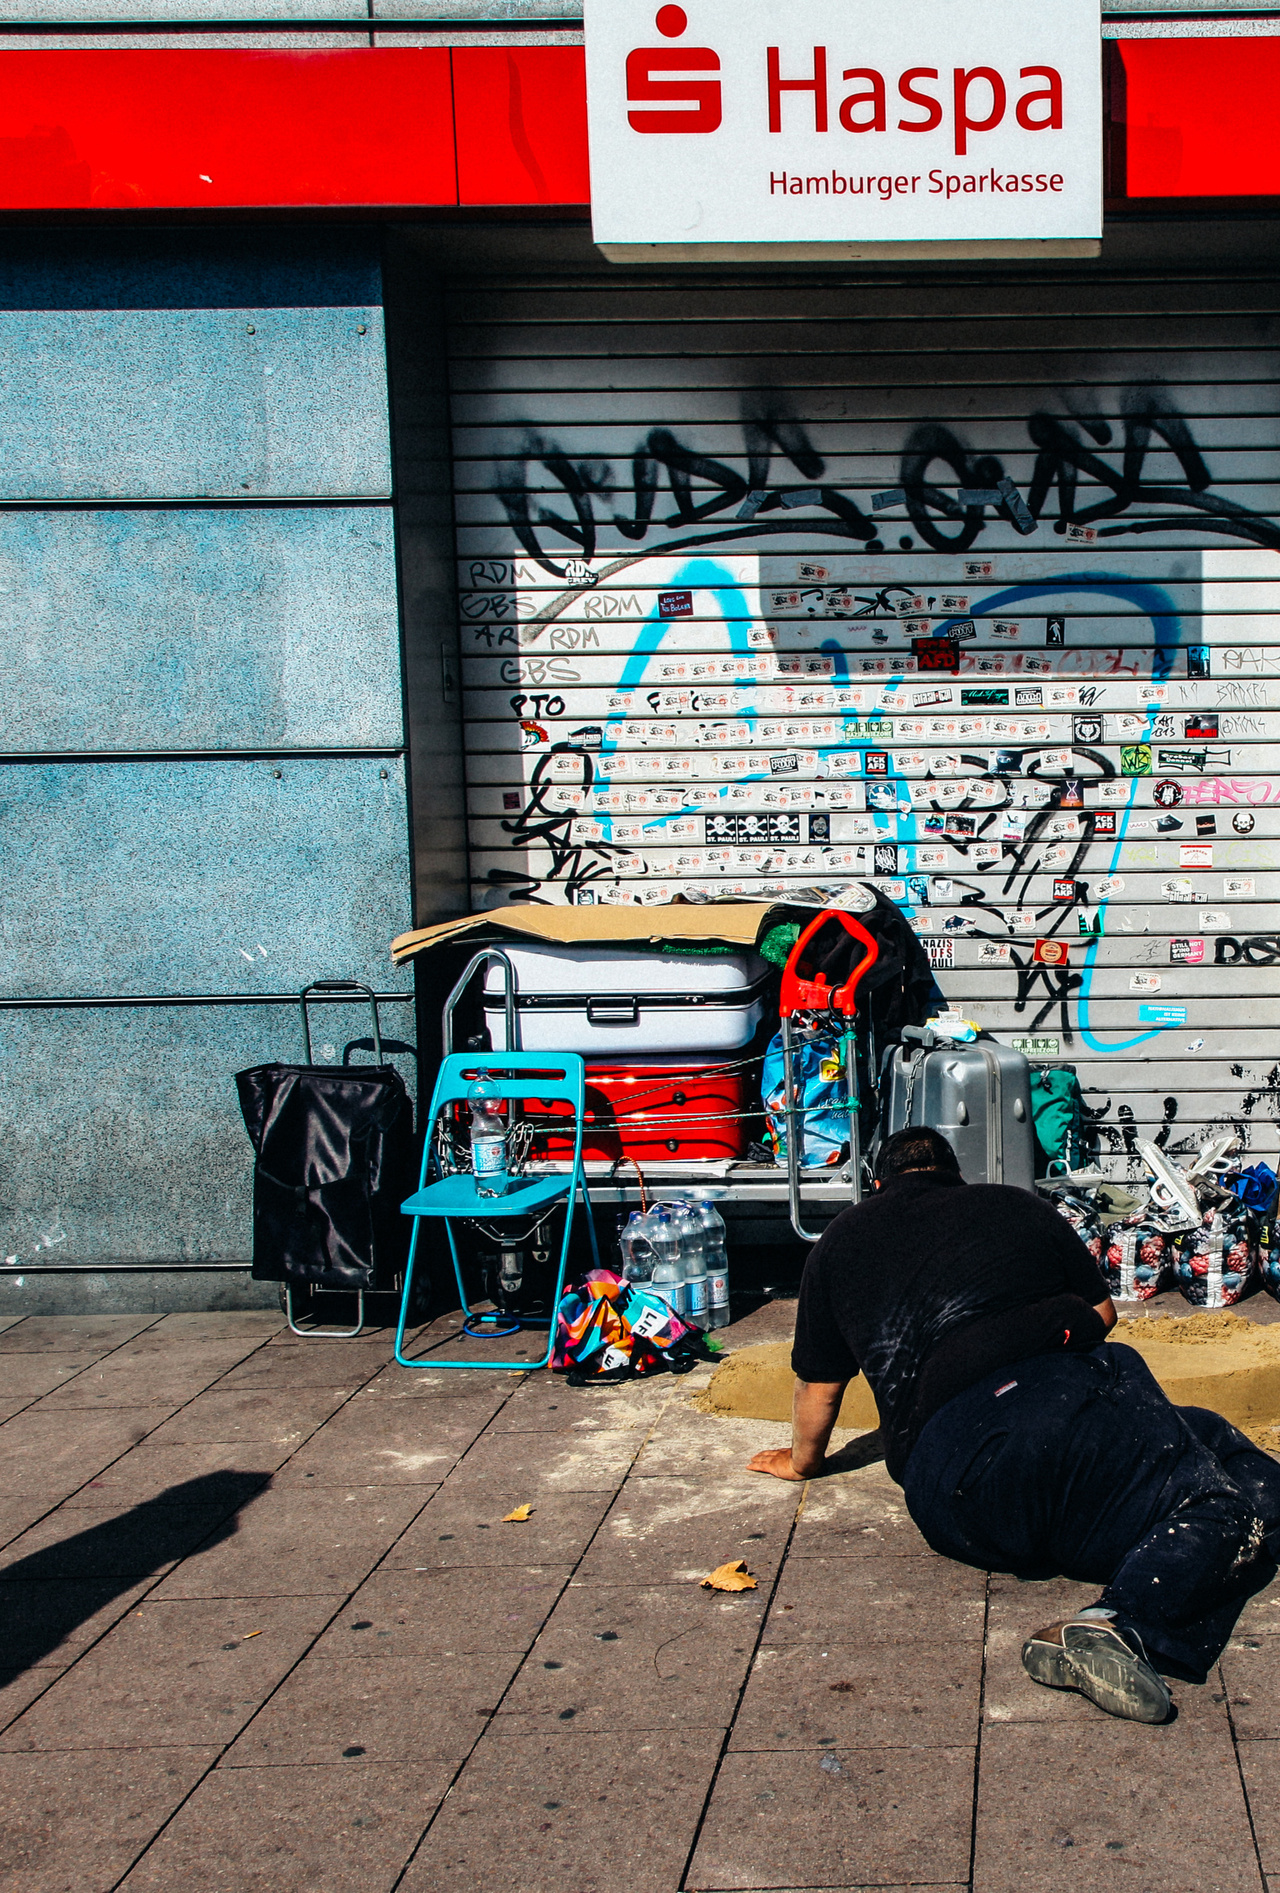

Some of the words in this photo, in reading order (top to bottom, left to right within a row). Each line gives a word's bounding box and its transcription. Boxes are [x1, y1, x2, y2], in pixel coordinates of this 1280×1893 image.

[767, 46, 1064, 155] Haspa
[769, 171, 921, 200] Hamburger
[928, 168, 1064, 198] Sparkasse
[922, 939, 953, 948] NAZIS
[930, 948, 953, 958] UFS
[928, 958, 953, 968] AUL!
